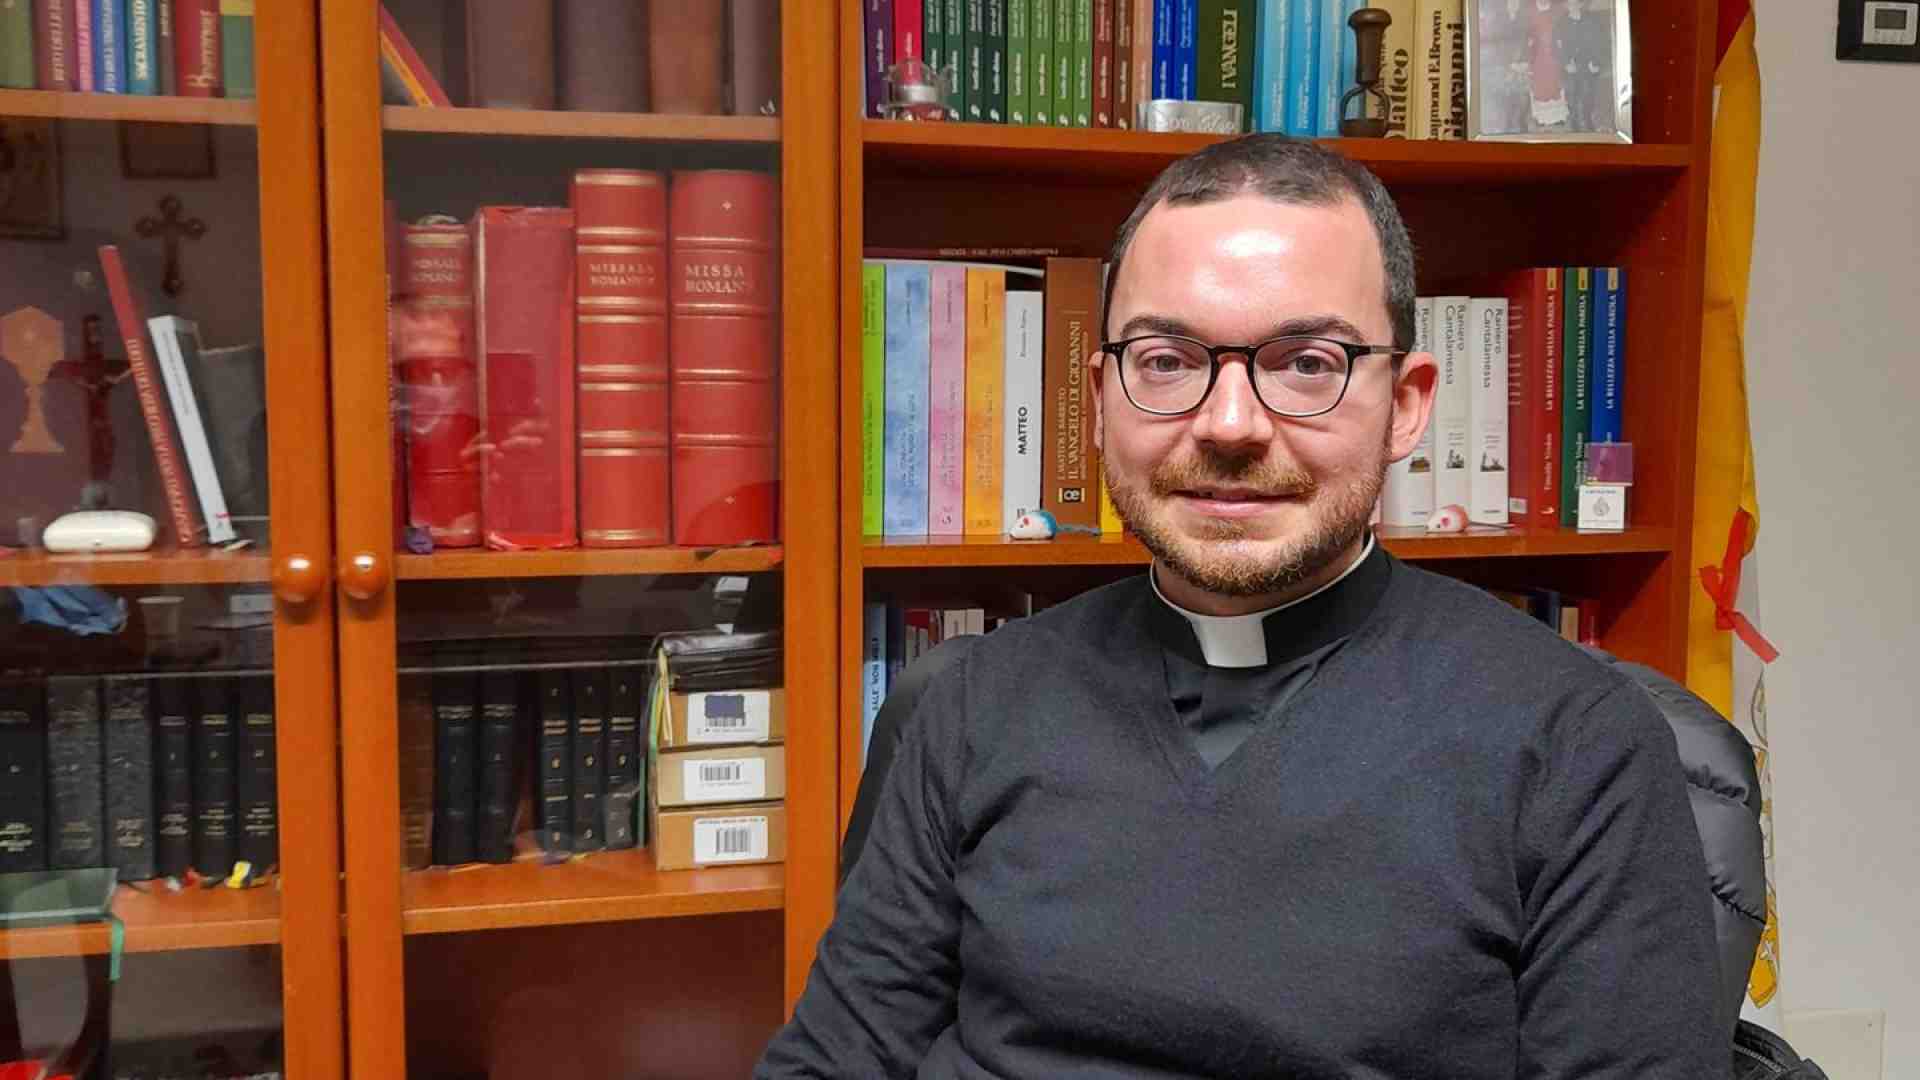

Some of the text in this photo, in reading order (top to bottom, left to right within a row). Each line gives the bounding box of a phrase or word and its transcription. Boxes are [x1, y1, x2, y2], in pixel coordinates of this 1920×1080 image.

[1221, 9, 1237, 81] VANGELI
[1445, 23, 1465, 137] iovanni
[1388, 48, 1408, 139] atteo
[1428, 77, 1442, 139] aymond
[1446, 305, 1456, 385] Cantalamessa
[1457, 304, 1466, 351] Raniero
[1484, 308, 1494, 388] Cantalamessa
[1495, 308, 1504, 354] Raniero
[1017, 406, 1028, 455] MATTEO
[1068, 320, 1081, 480] IL VANGELO DI GIOVANNI
